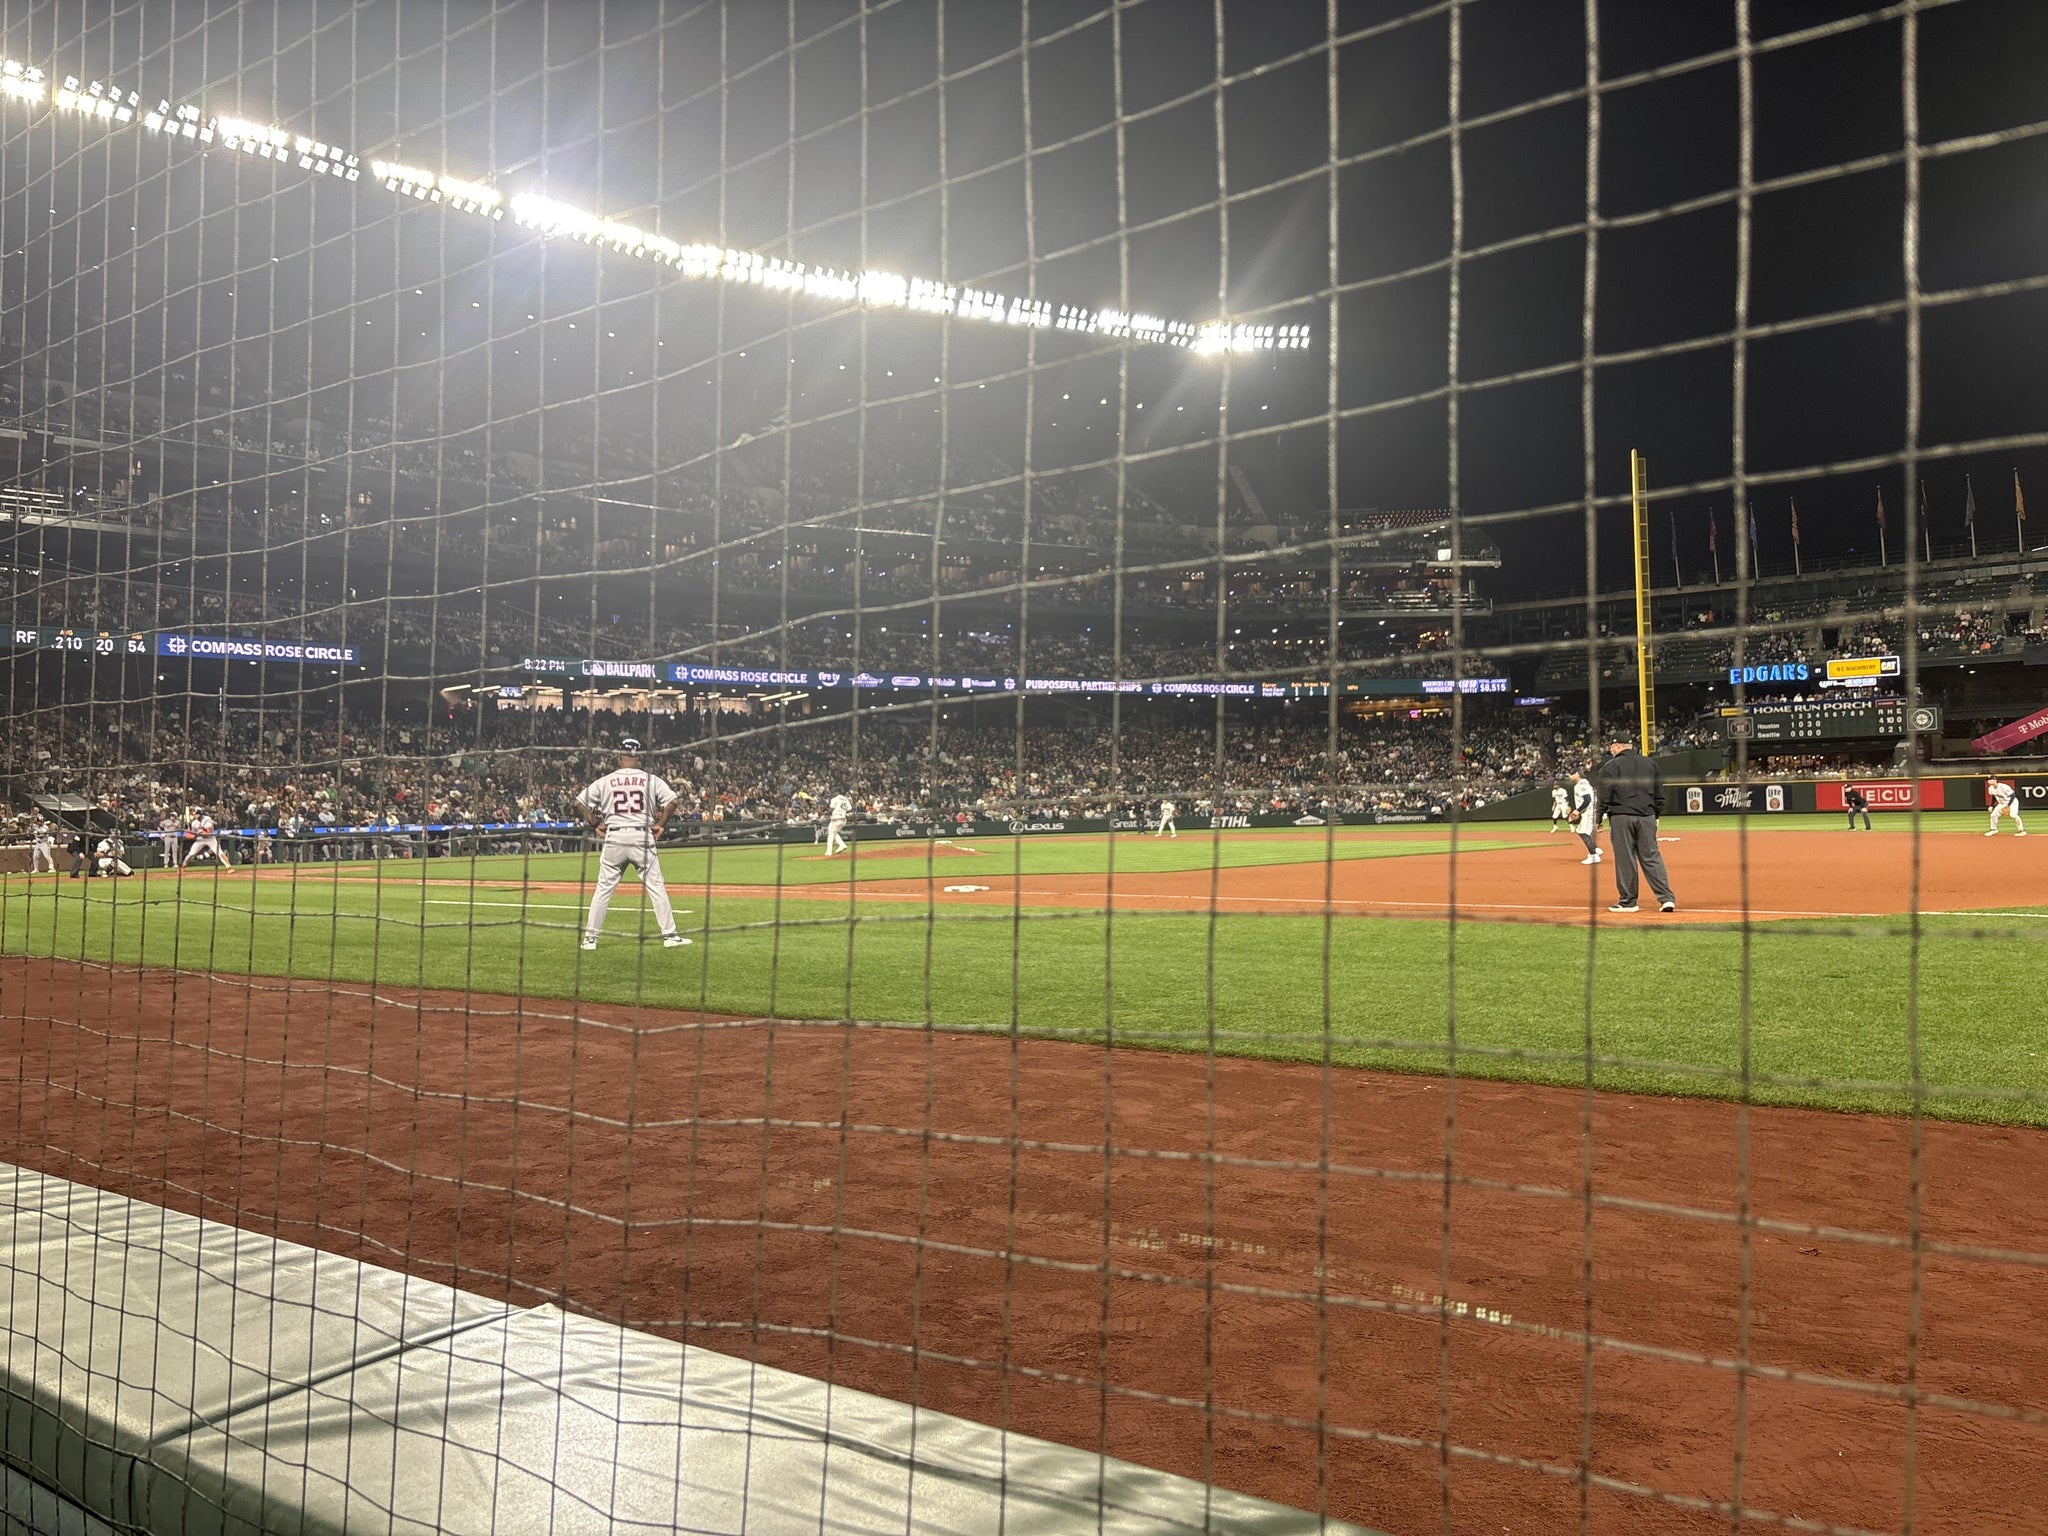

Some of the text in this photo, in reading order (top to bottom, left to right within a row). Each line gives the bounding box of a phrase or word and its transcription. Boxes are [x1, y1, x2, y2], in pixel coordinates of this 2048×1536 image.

[16, 630, 37, 644] RF
[51, 636, 82, 650] .210
[96, 639, 114, 652] 20
[128, 640, 146, 653] 54
[191, 640, 353, 661] COMPASS ROSE CIRCLE
[524, 658, 565, 671] 8:22 PM
[606, 662, 656, 678] BALLPARK
[1845, 664, 1876, 672] MACHINERY
[1881, 661, 1897, 671] CAT
[690, 668, 808, 684] COMPASS ROSE CIRCLE
[1025, 679, 1080, 691] PURPOSEFUL
[1163, 683, 1255, 694] COMPASS ROSE CIRCLE
[1753, 704, 1792, 715] HOME
[1793, 703, 1821, 713] RUN
[1822, 700, 1872, 711] PORCH
[610, 776, 646, 788] CLARK
[1688, 790, 1701, 800] Lite
[1768, 788, 1781, 798] Lite
[1865, 789, 1911, 801] ECU
[2021, 785, 2048, 798] TO
[613, 790, 644, 814] 23
[1024, 822, 1065, 831] LEXUS
[1110, 818, 1138, 829] Great
[1209, 815, 1251, 829] STIHL
